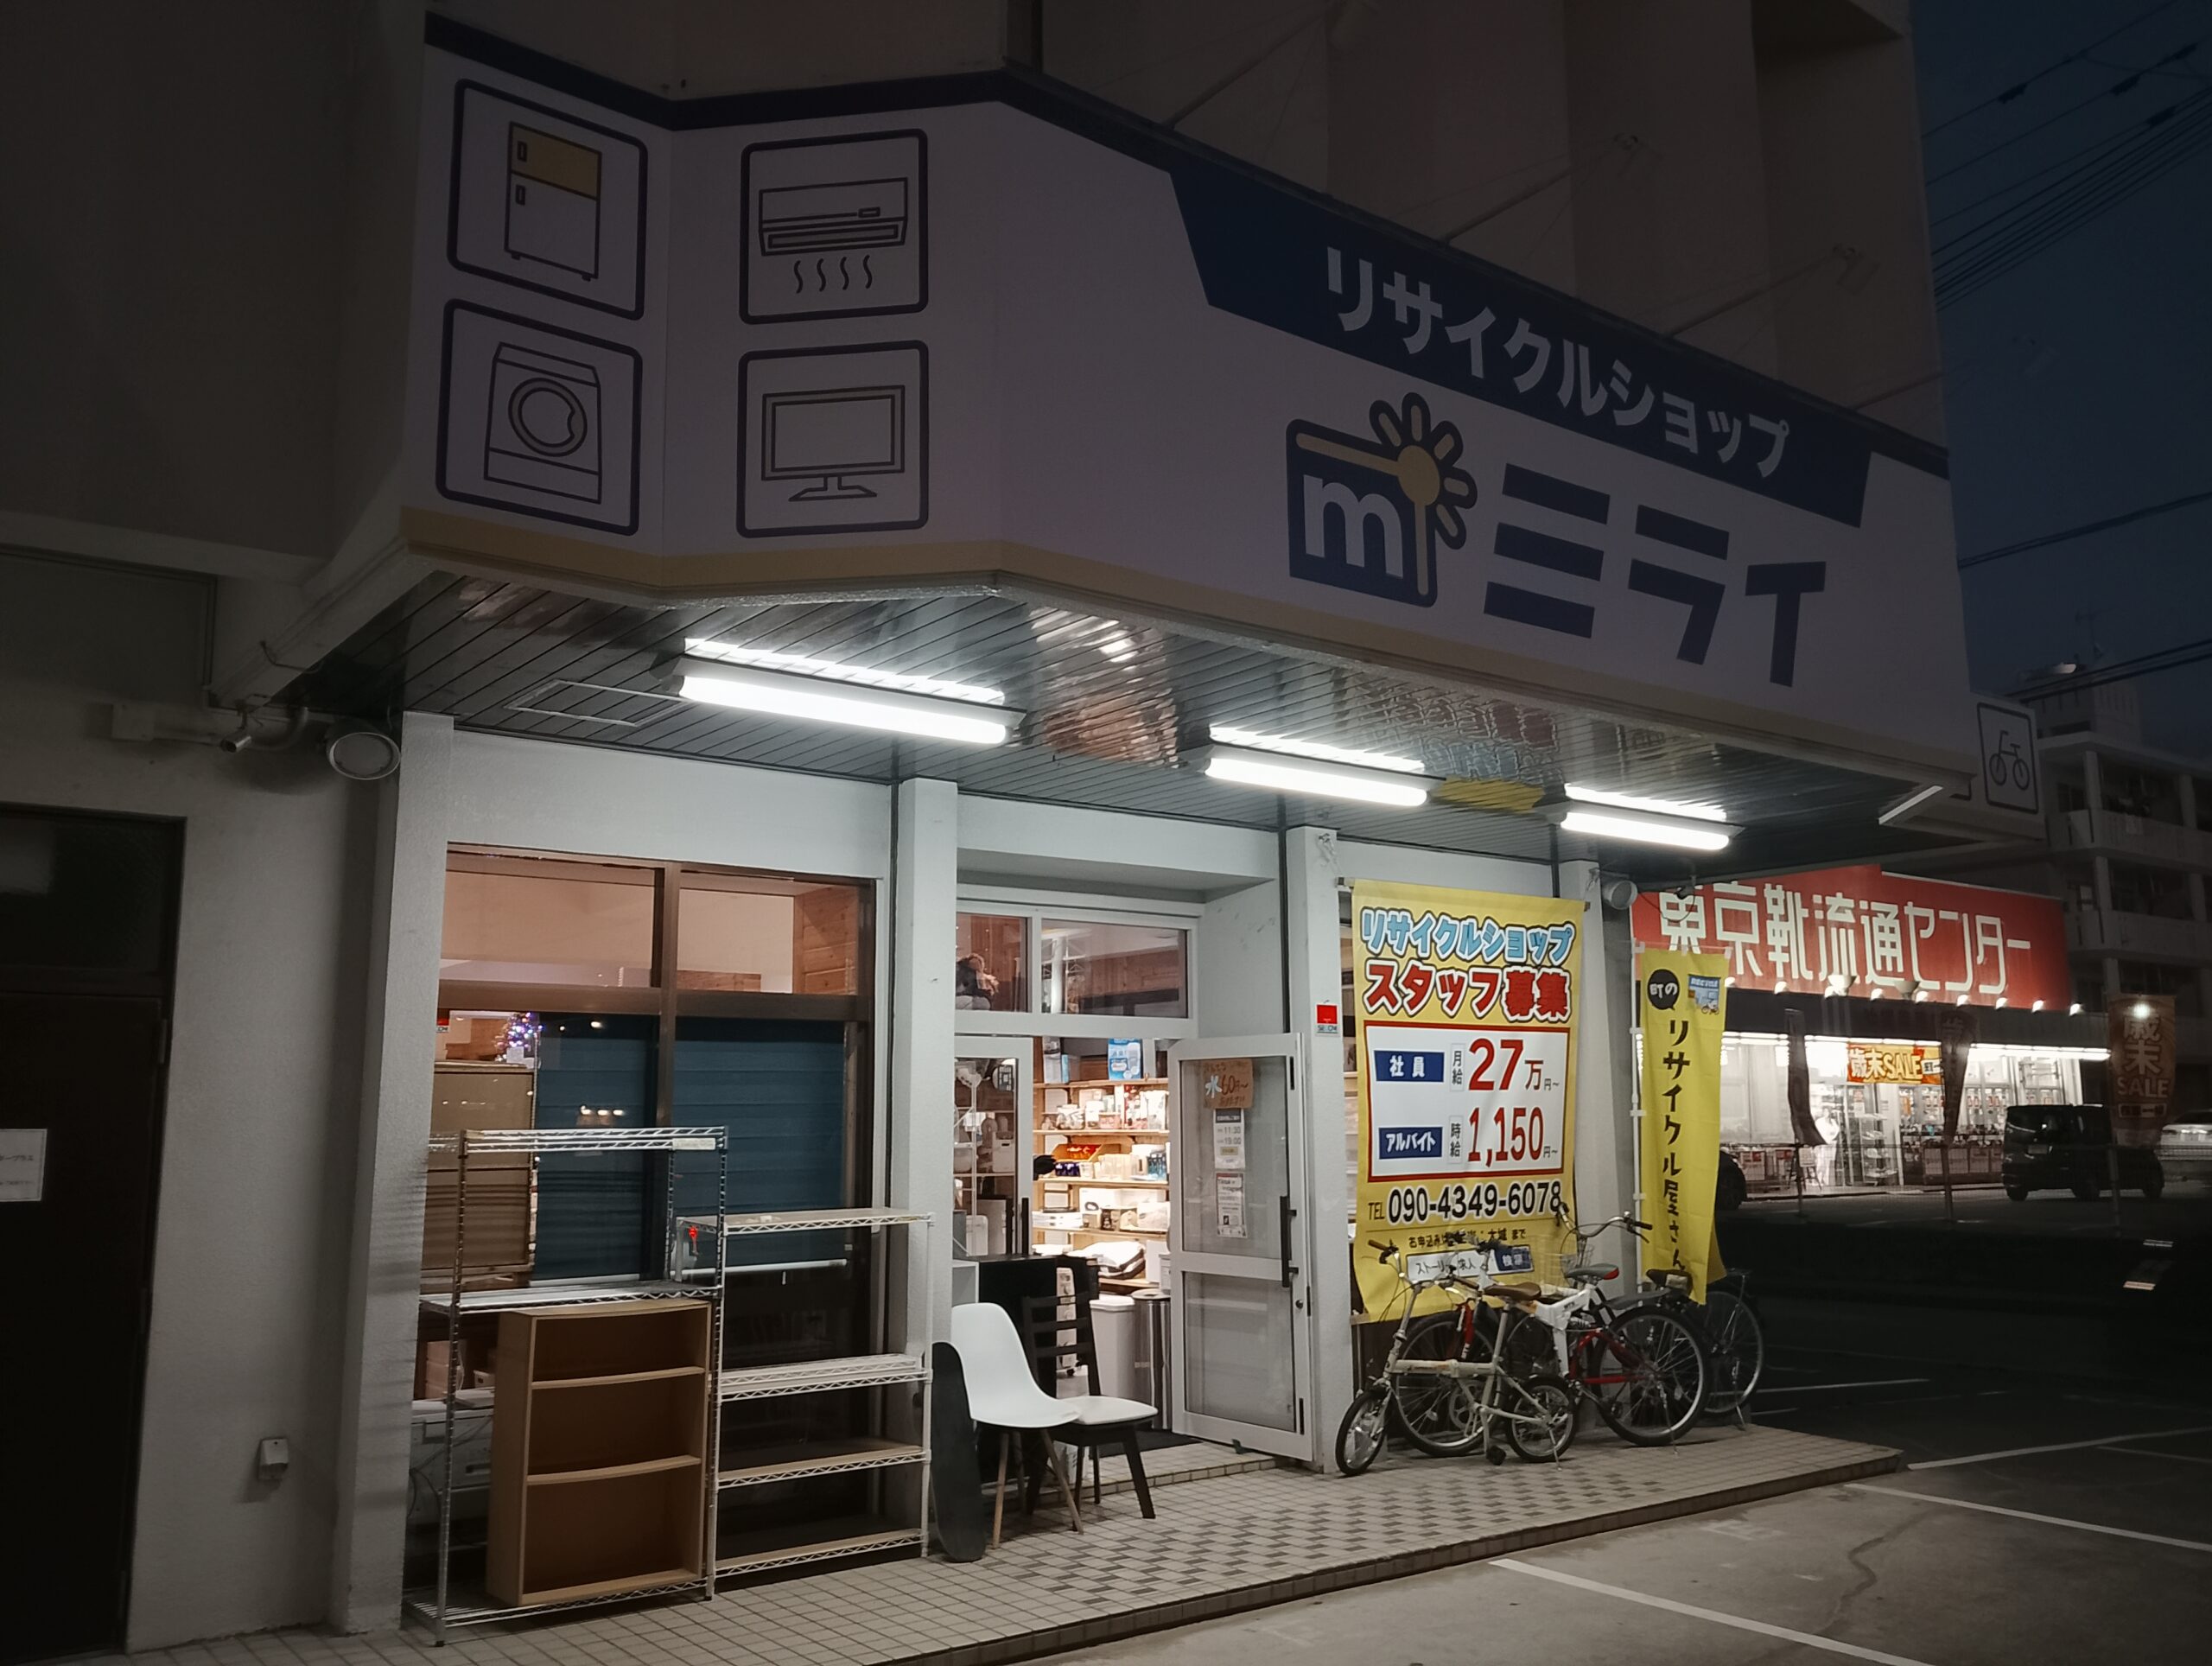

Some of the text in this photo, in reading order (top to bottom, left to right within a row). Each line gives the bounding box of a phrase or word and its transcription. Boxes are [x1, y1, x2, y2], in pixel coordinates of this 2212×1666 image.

[1326, 246, 1789, 478] リサイクルショップ
[1484, 462, 1827, 688] ミライ
[1362, 907, 1577, 966] リサイクルショップ
[1659, 881, 2031, 995] 東京靴流通センター
[1363, 958, 1572, 1022] スタッフ募集
[1649, 982, 1678, 998] 町の
[1389, 1055, 1426, 1078] 社員
[1452, 1050, 1463, 1085] 月給
[2117, 1077, 2169, 1097] SALE
[1385, 1131, 1436, 1153] アルバイト
[1450, 1123, 1462, 1157] 時給
[1662, 1020, 1691, 1270] リサイクル屋さん
[1368, 1180, 1561, 1224] TEL 090-4349-6078
